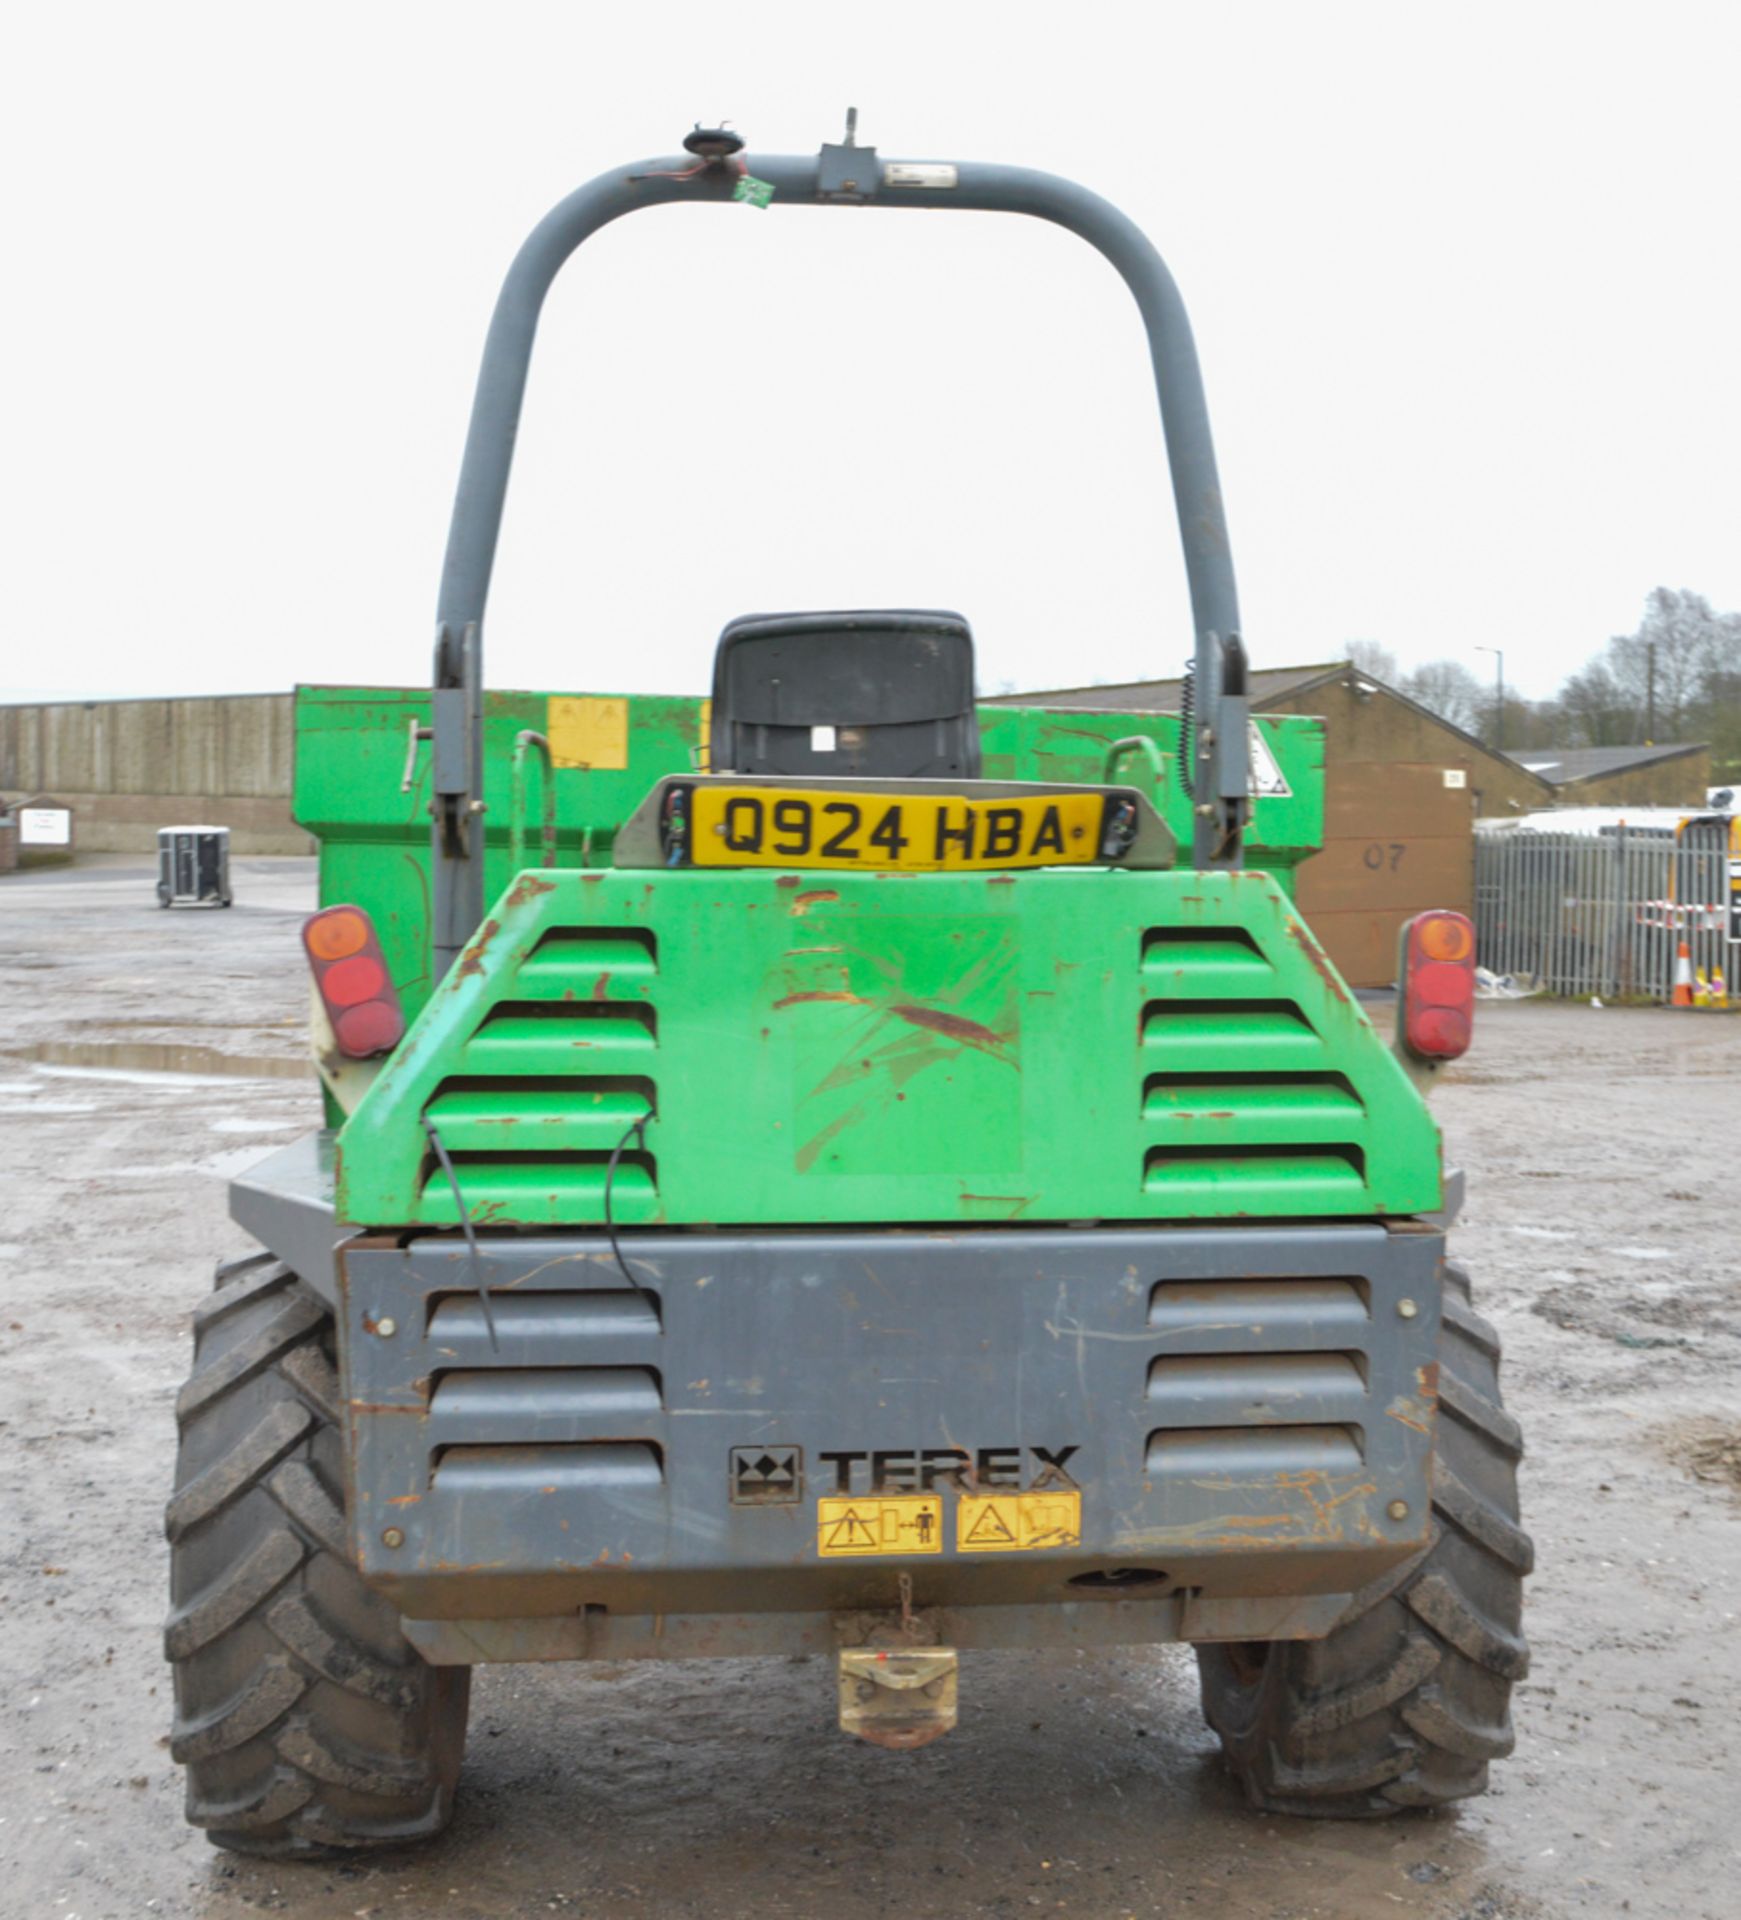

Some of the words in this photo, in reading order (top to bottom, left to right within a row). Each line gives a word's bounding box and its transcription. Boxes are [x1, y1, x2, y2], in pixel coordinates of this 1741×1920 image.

[724, 797, 909, 861] Q924
[935, 804, 1065, 861] HBA
[1362, 843, 1407, 873] 07
[818, 1446, 1080, 1493] TEREX
